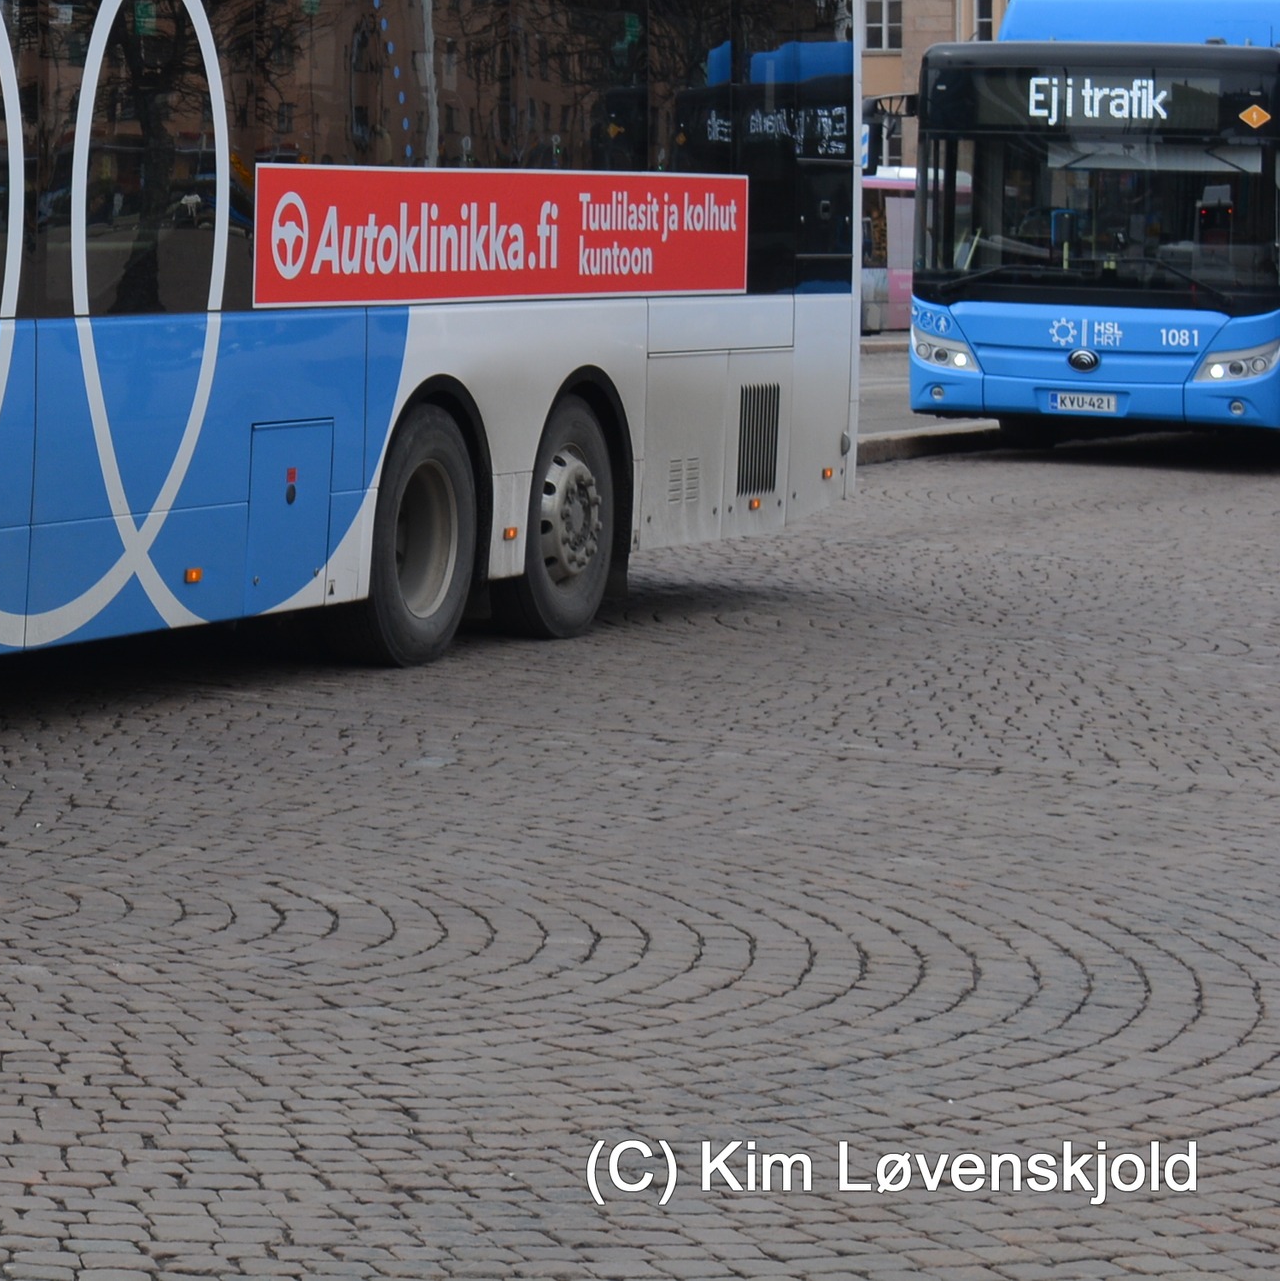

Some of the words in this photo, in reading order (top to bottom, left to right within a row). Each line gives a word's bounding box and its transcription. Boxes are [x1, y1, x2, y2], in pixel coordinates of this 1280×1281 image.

[1029, 77, 1059, 126] Ej
[1065, 77, 1074, 118] i
[1081, 78, 1168, 120] trafik
[309, 201, 559, 275] Autoklinikka.fi
[579, 192, 659, 231] Tuulilasit
[661, 193, 678, 242] ja
[683, 192, 738, 231] kolhut
[578, 236, 653, 276] kuntoon
[1093, 321, 1123, 335] HSL
[1160, 328, 1199, 347] 1081
[1093, 334, 1123, 347] HRT
[1059, 395, 1111, 410] KVU-421
